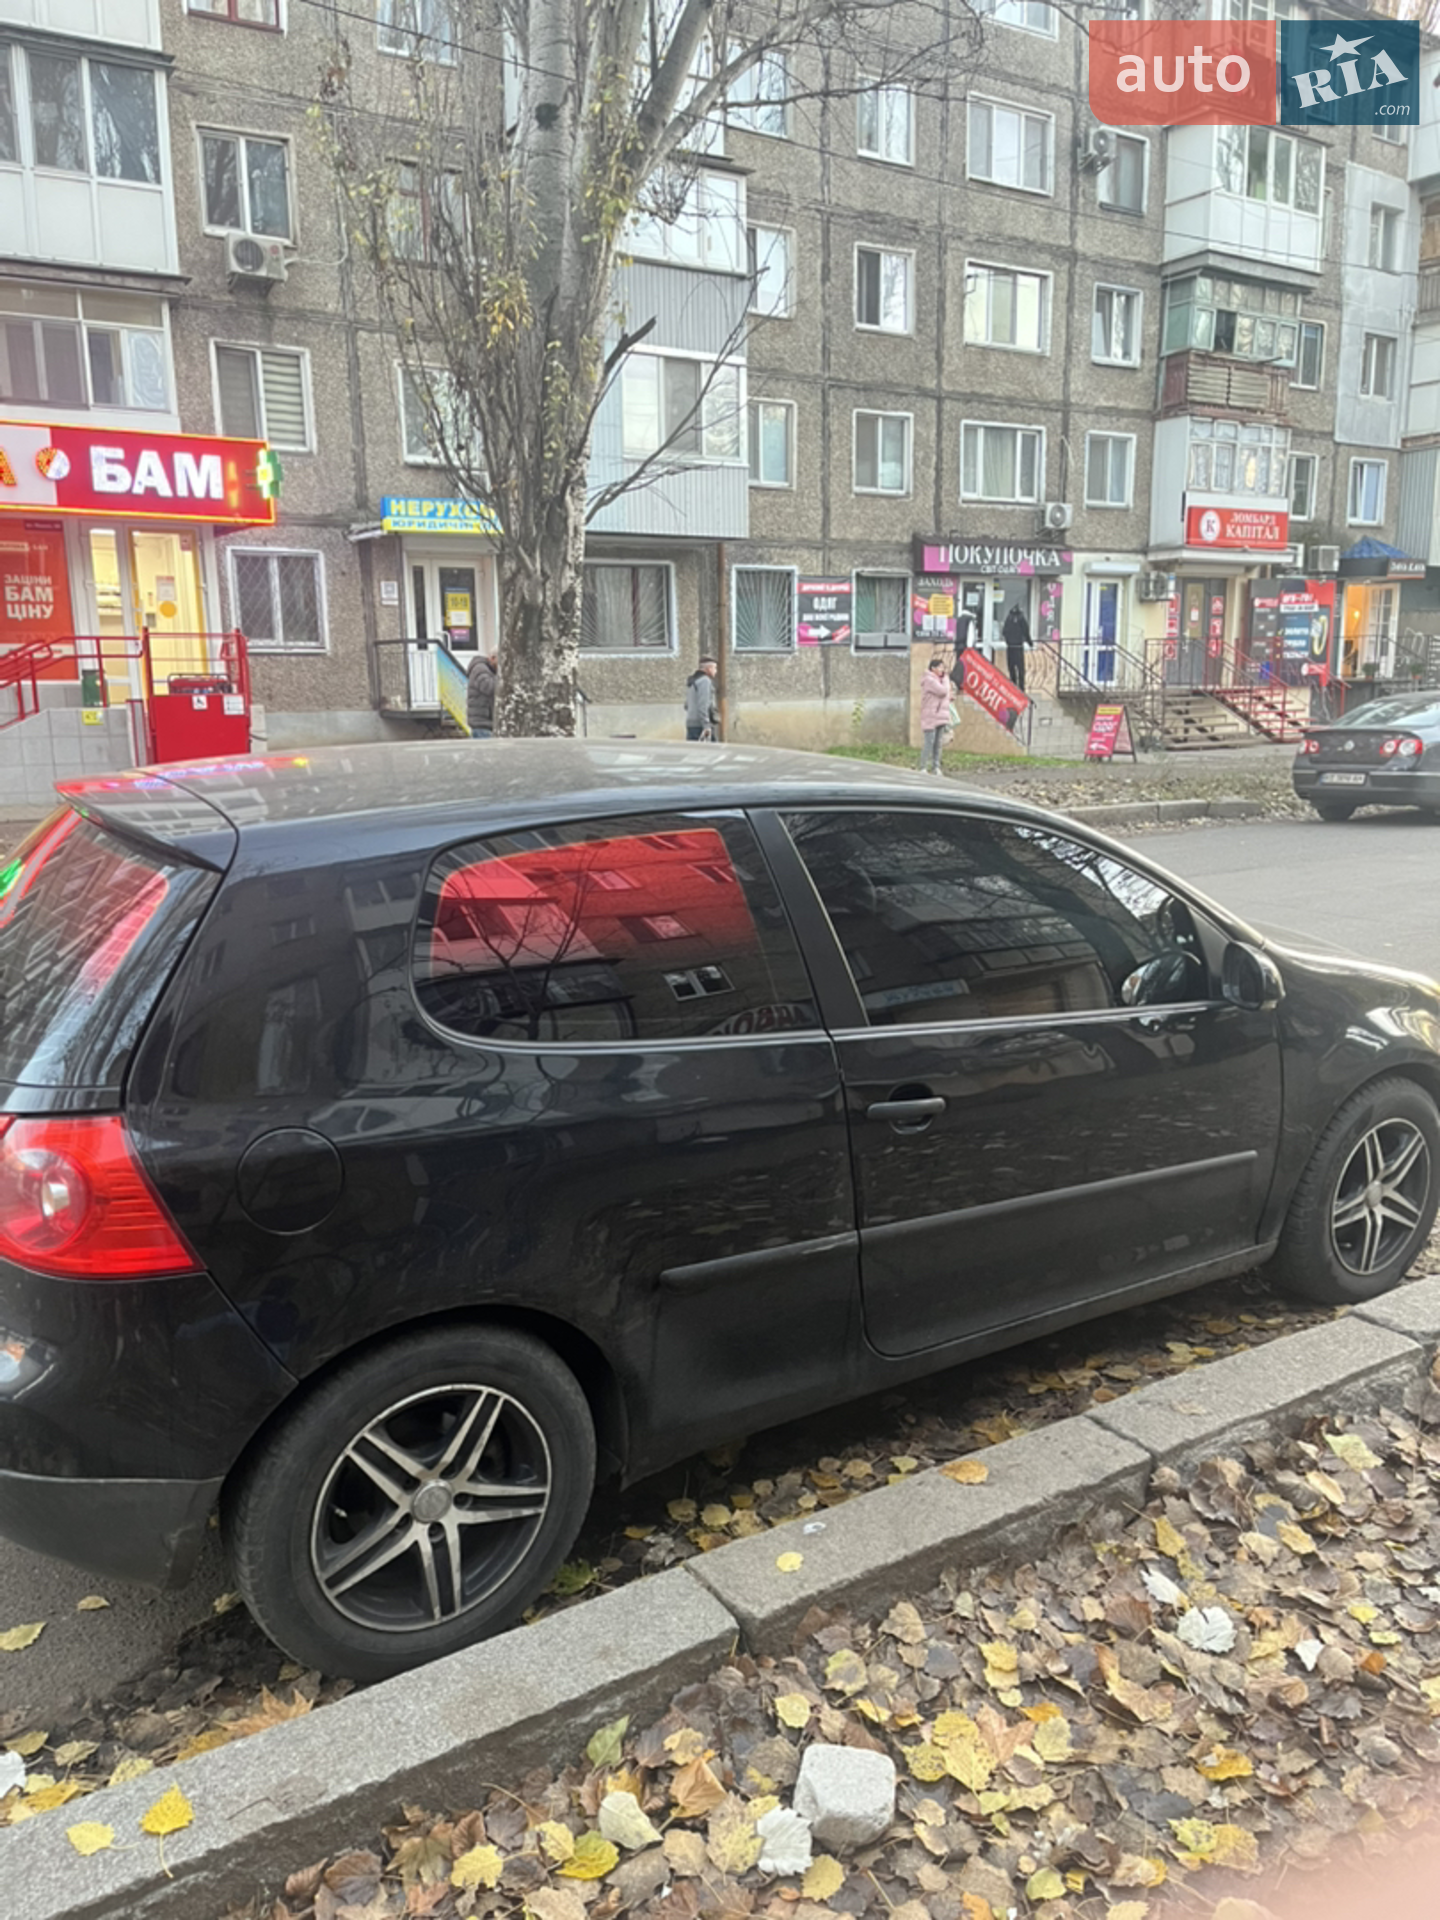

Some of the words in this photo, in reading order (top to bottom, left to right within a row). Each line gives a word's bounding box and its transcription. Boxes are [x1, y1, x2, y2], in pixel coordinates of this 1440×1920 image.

[90, 445, 224, 499] БАМ
[939, 544, 1061, 567] ПОКУПОЧКА
[5, 586, 54, 602] БАМ
[7, 603, 54, 621] ЦІНУ
[967, 671, 1006, 711] ОДЯГ
